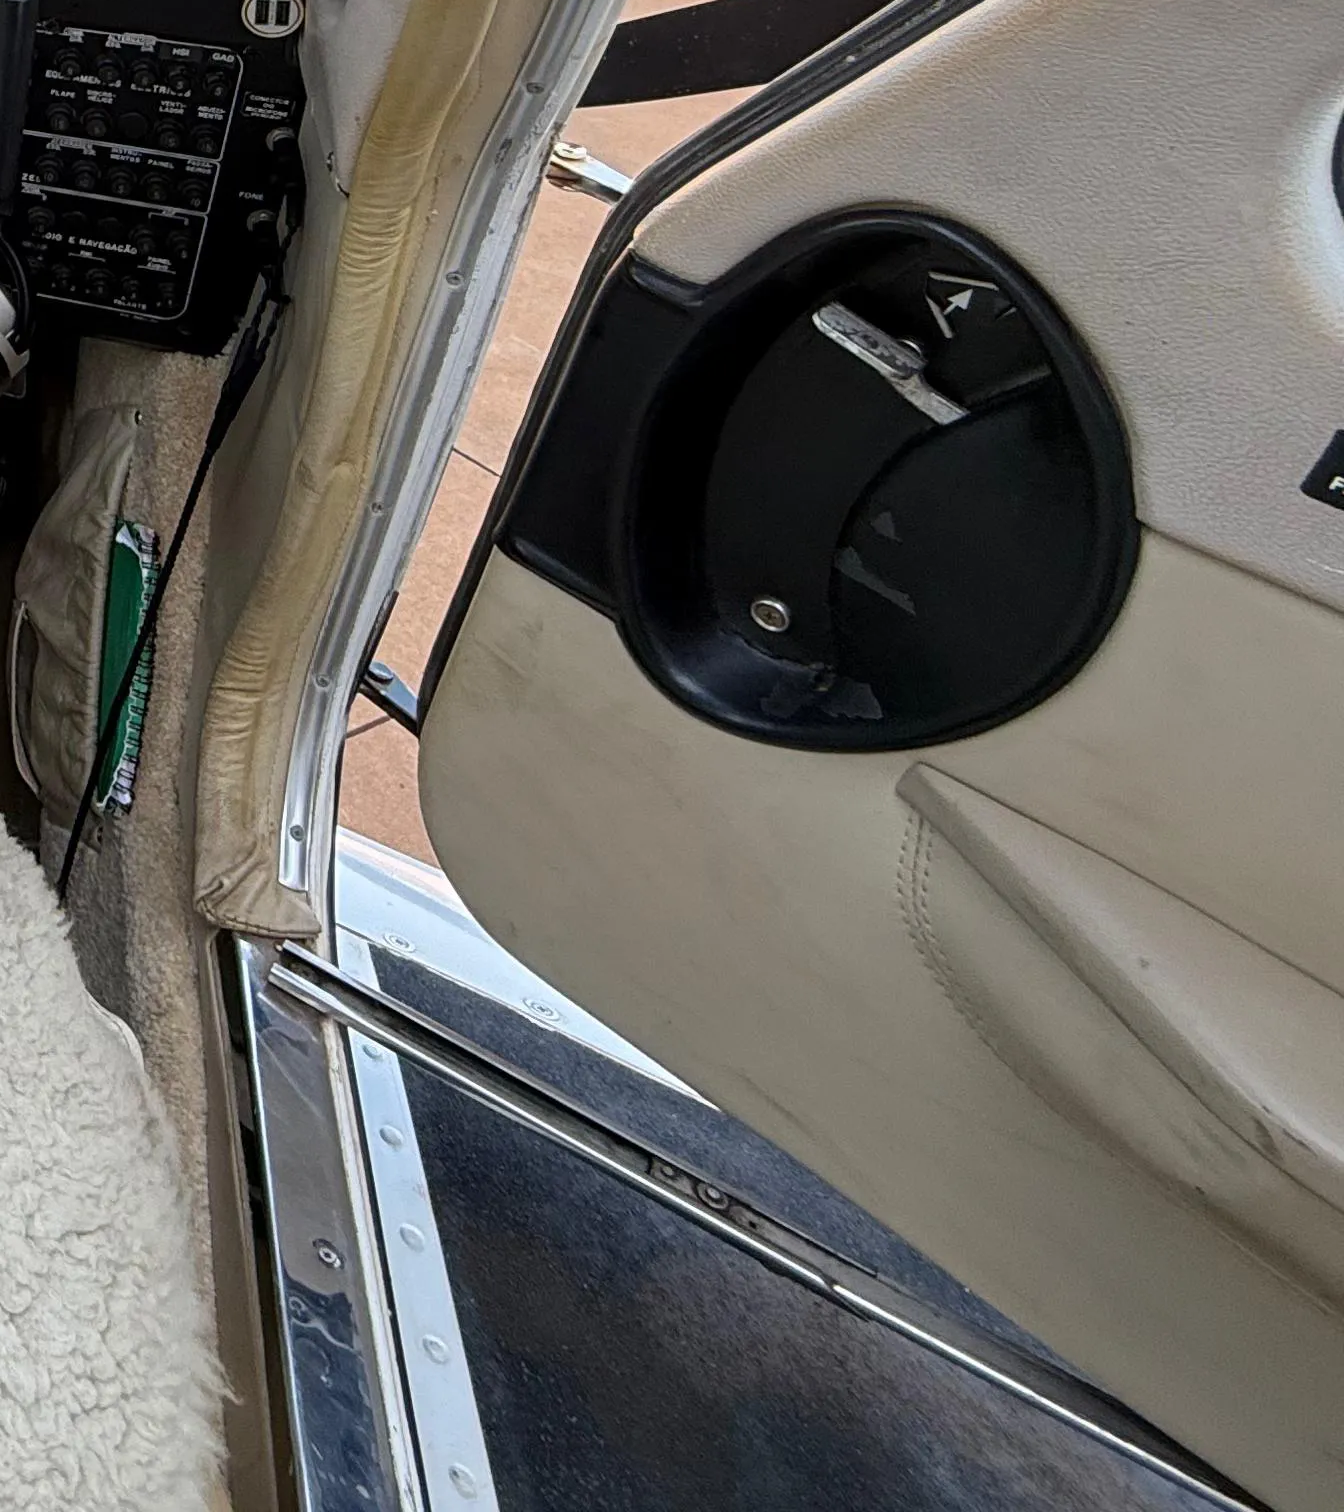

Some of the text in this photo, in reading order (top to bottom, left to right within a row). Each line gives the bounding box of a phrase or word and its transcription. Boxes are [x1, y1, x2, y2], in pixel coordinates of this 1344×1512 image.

[172, 48, 191, 57] HSI
[238, 191, 264, 201] FONE
[68, 236, 138, 256] E NAVEGAÇÃO
